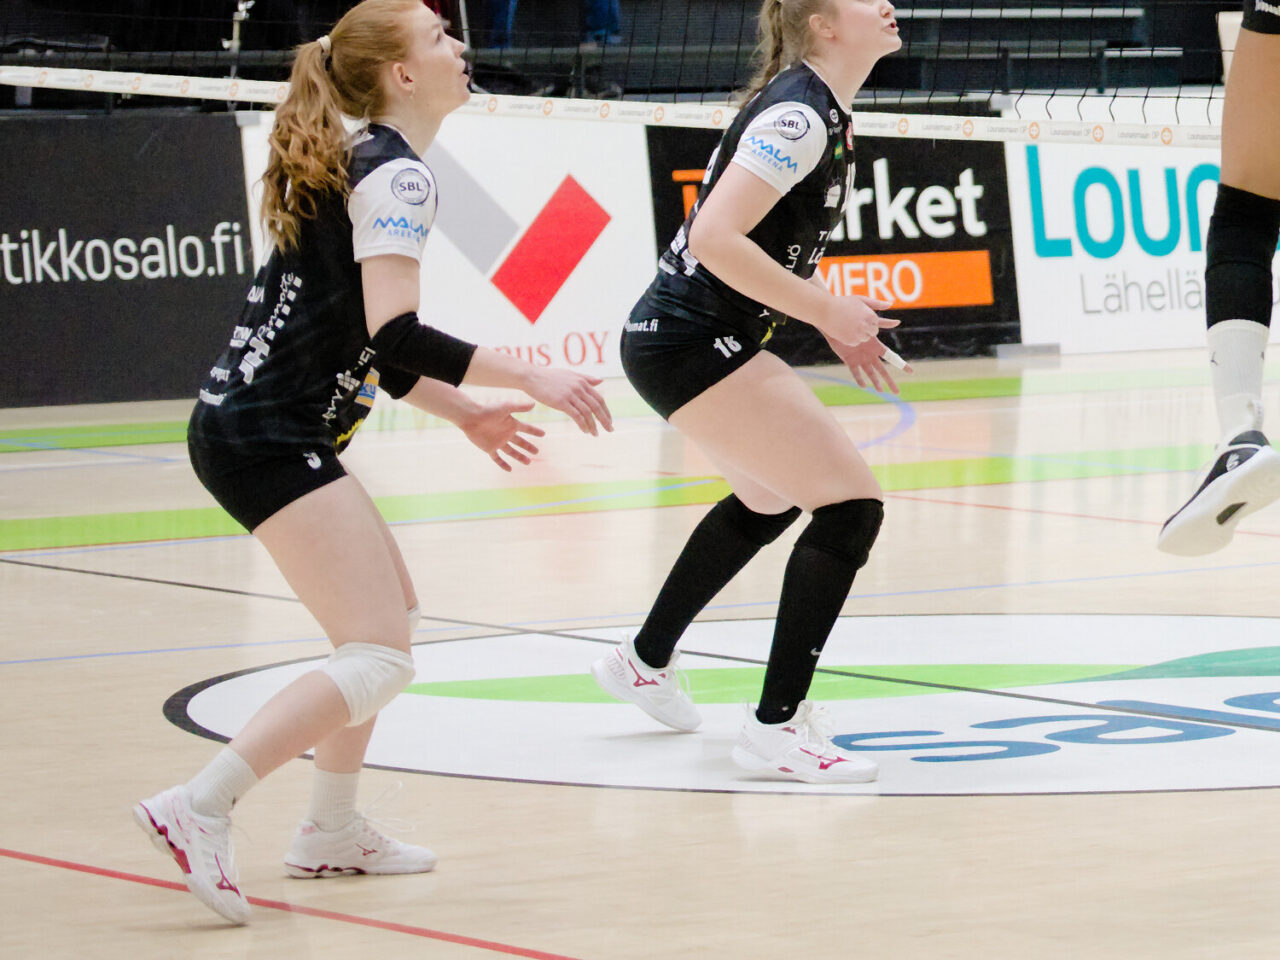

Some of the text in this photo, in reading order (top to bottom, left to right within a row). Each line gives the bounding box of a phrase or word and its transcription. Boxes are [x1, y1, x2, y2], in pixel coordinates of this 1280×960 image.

[780, 119, 801, 130] SBL
[398, 182, 423, 192] SBL
[818, 261, 923, 302] MERO
[1081, 269, 1204, 315] Lähellä
[563, 330, 609, 367] OY
